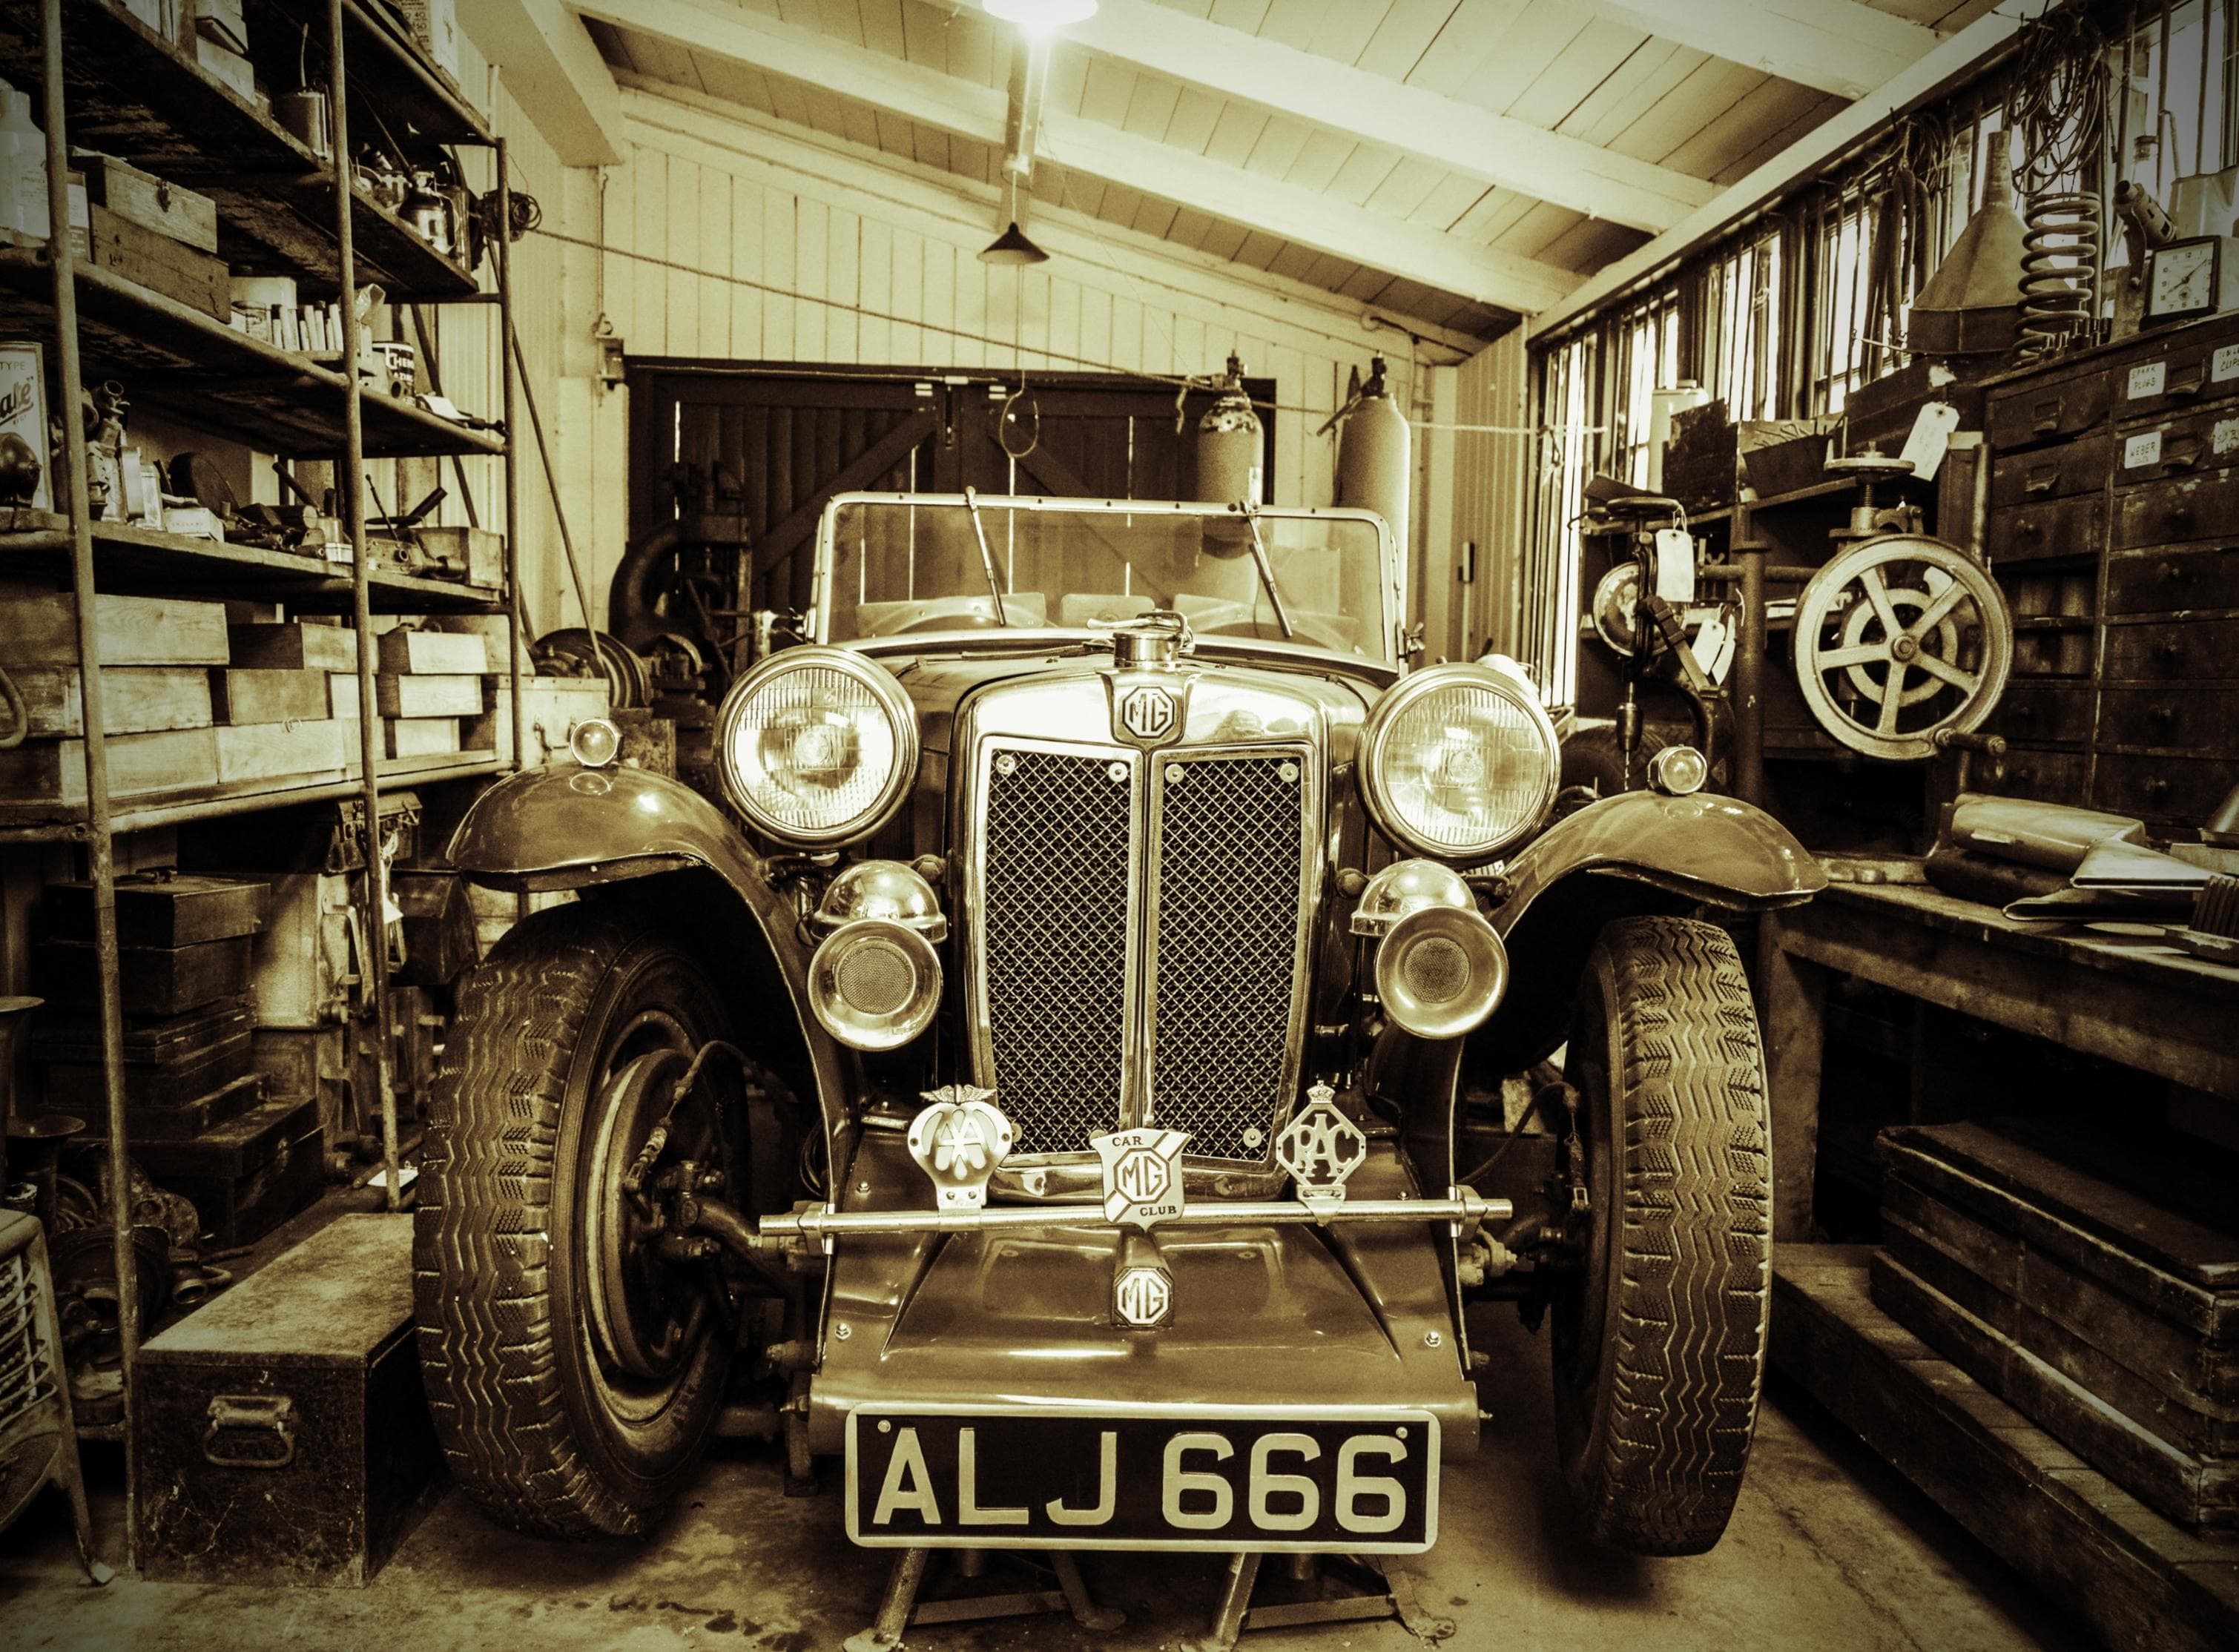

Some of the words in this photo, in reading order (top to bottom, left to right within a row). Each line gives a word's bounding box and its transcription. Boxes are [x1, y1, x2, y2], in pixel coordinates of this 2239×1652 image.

[2134, 377, 2156, 391] PLUGS
[1129, 693, 1169, 733] MG
[1112, 1135, 1144, 1147] CAR
[1292, 1113, 1353, 1177] RAC
[1121, 1155, 1164, 1197] MG
[1139, 1205, 1178, 1217] CLUB
[1121, 1277, 1164, 1320] MG
[872, 1427, 1118, 1527] ALJ
[1162, 1430, 1408, 1533] 666
